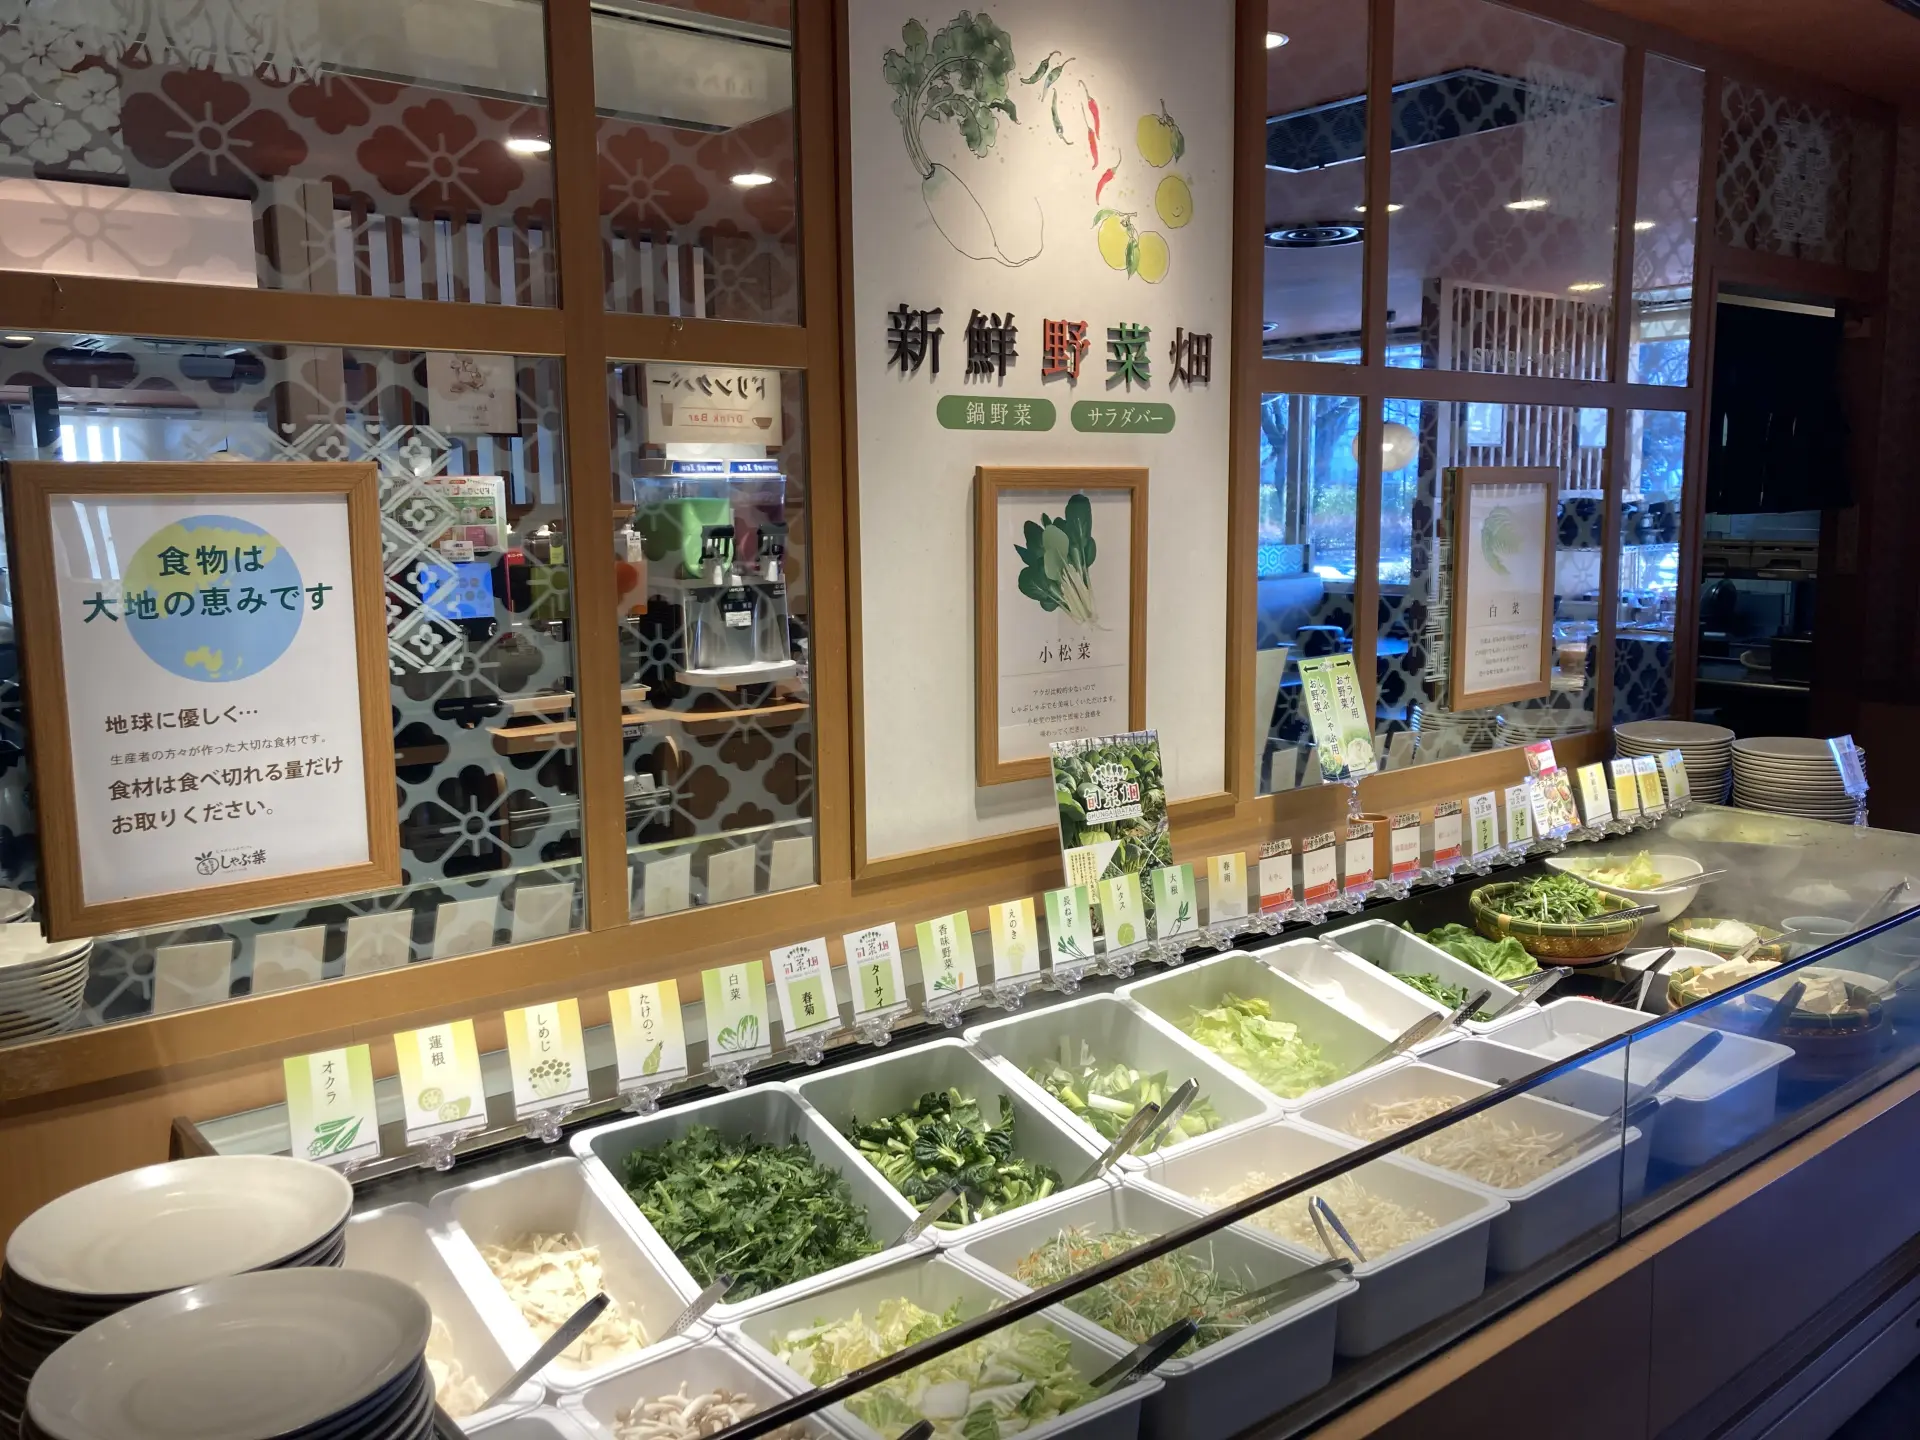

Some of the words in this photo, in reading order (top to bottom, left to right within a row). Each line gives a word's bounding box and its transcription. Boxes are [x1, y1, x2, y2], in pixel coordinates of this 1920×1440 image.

[887, 303, 1213, 383] 新鮮野菜畑
[965, 401, 1032, 426] 鍋野菜
[1087, 406, 1164, 428] サラダバー
[157, 544, 264, 577] 食物は
[83, 582, 333, 623] 大地の恵みです
[1490, 602, 1519, 618] 白菜
[1039, 642, 1091, 664] 小松菜
[1310, 680, 1322, 713] お野菜
[1336, 676, 1349, 709] お野菜
[1344, 675, 1359, 719] サラダ用
[1318, 678, 1339, 754] しゃぶしゃぶ用
[110, 735, 326, 766] 生産者の方々が作った大切な食材です。
[108, 756, 343, 800] 食材は食べ切れる量だけ
[1085, 783, 1139, 809] 旬菜畑
[112, 802, 274, 835] お取りください。
[221, 849, 266, 869] しゃぶ葉
[1223, 861, 1231, 882] 春雨
[1116, 884, 1126, 911] レタス
[1170, 874, 1179, 895] 大根
[1009, 908, 1018, 940] えのき
[1063, 896, 1073, 928] 長ねぎ
[938, 923, 954, 970] 香味野菜
[728, 973, 741, 1001] 白菜
[871, 964, 884, 1007] ターサイ
[639, 993, 655, 1043] たけのこ
[801, 991, 815, 1016] 春菊
[537, 1013, 551, 1052] しめじ
[428, 1035, 446, 1067] 蓮根
[322, 1060, 337, 1105] オクラ
